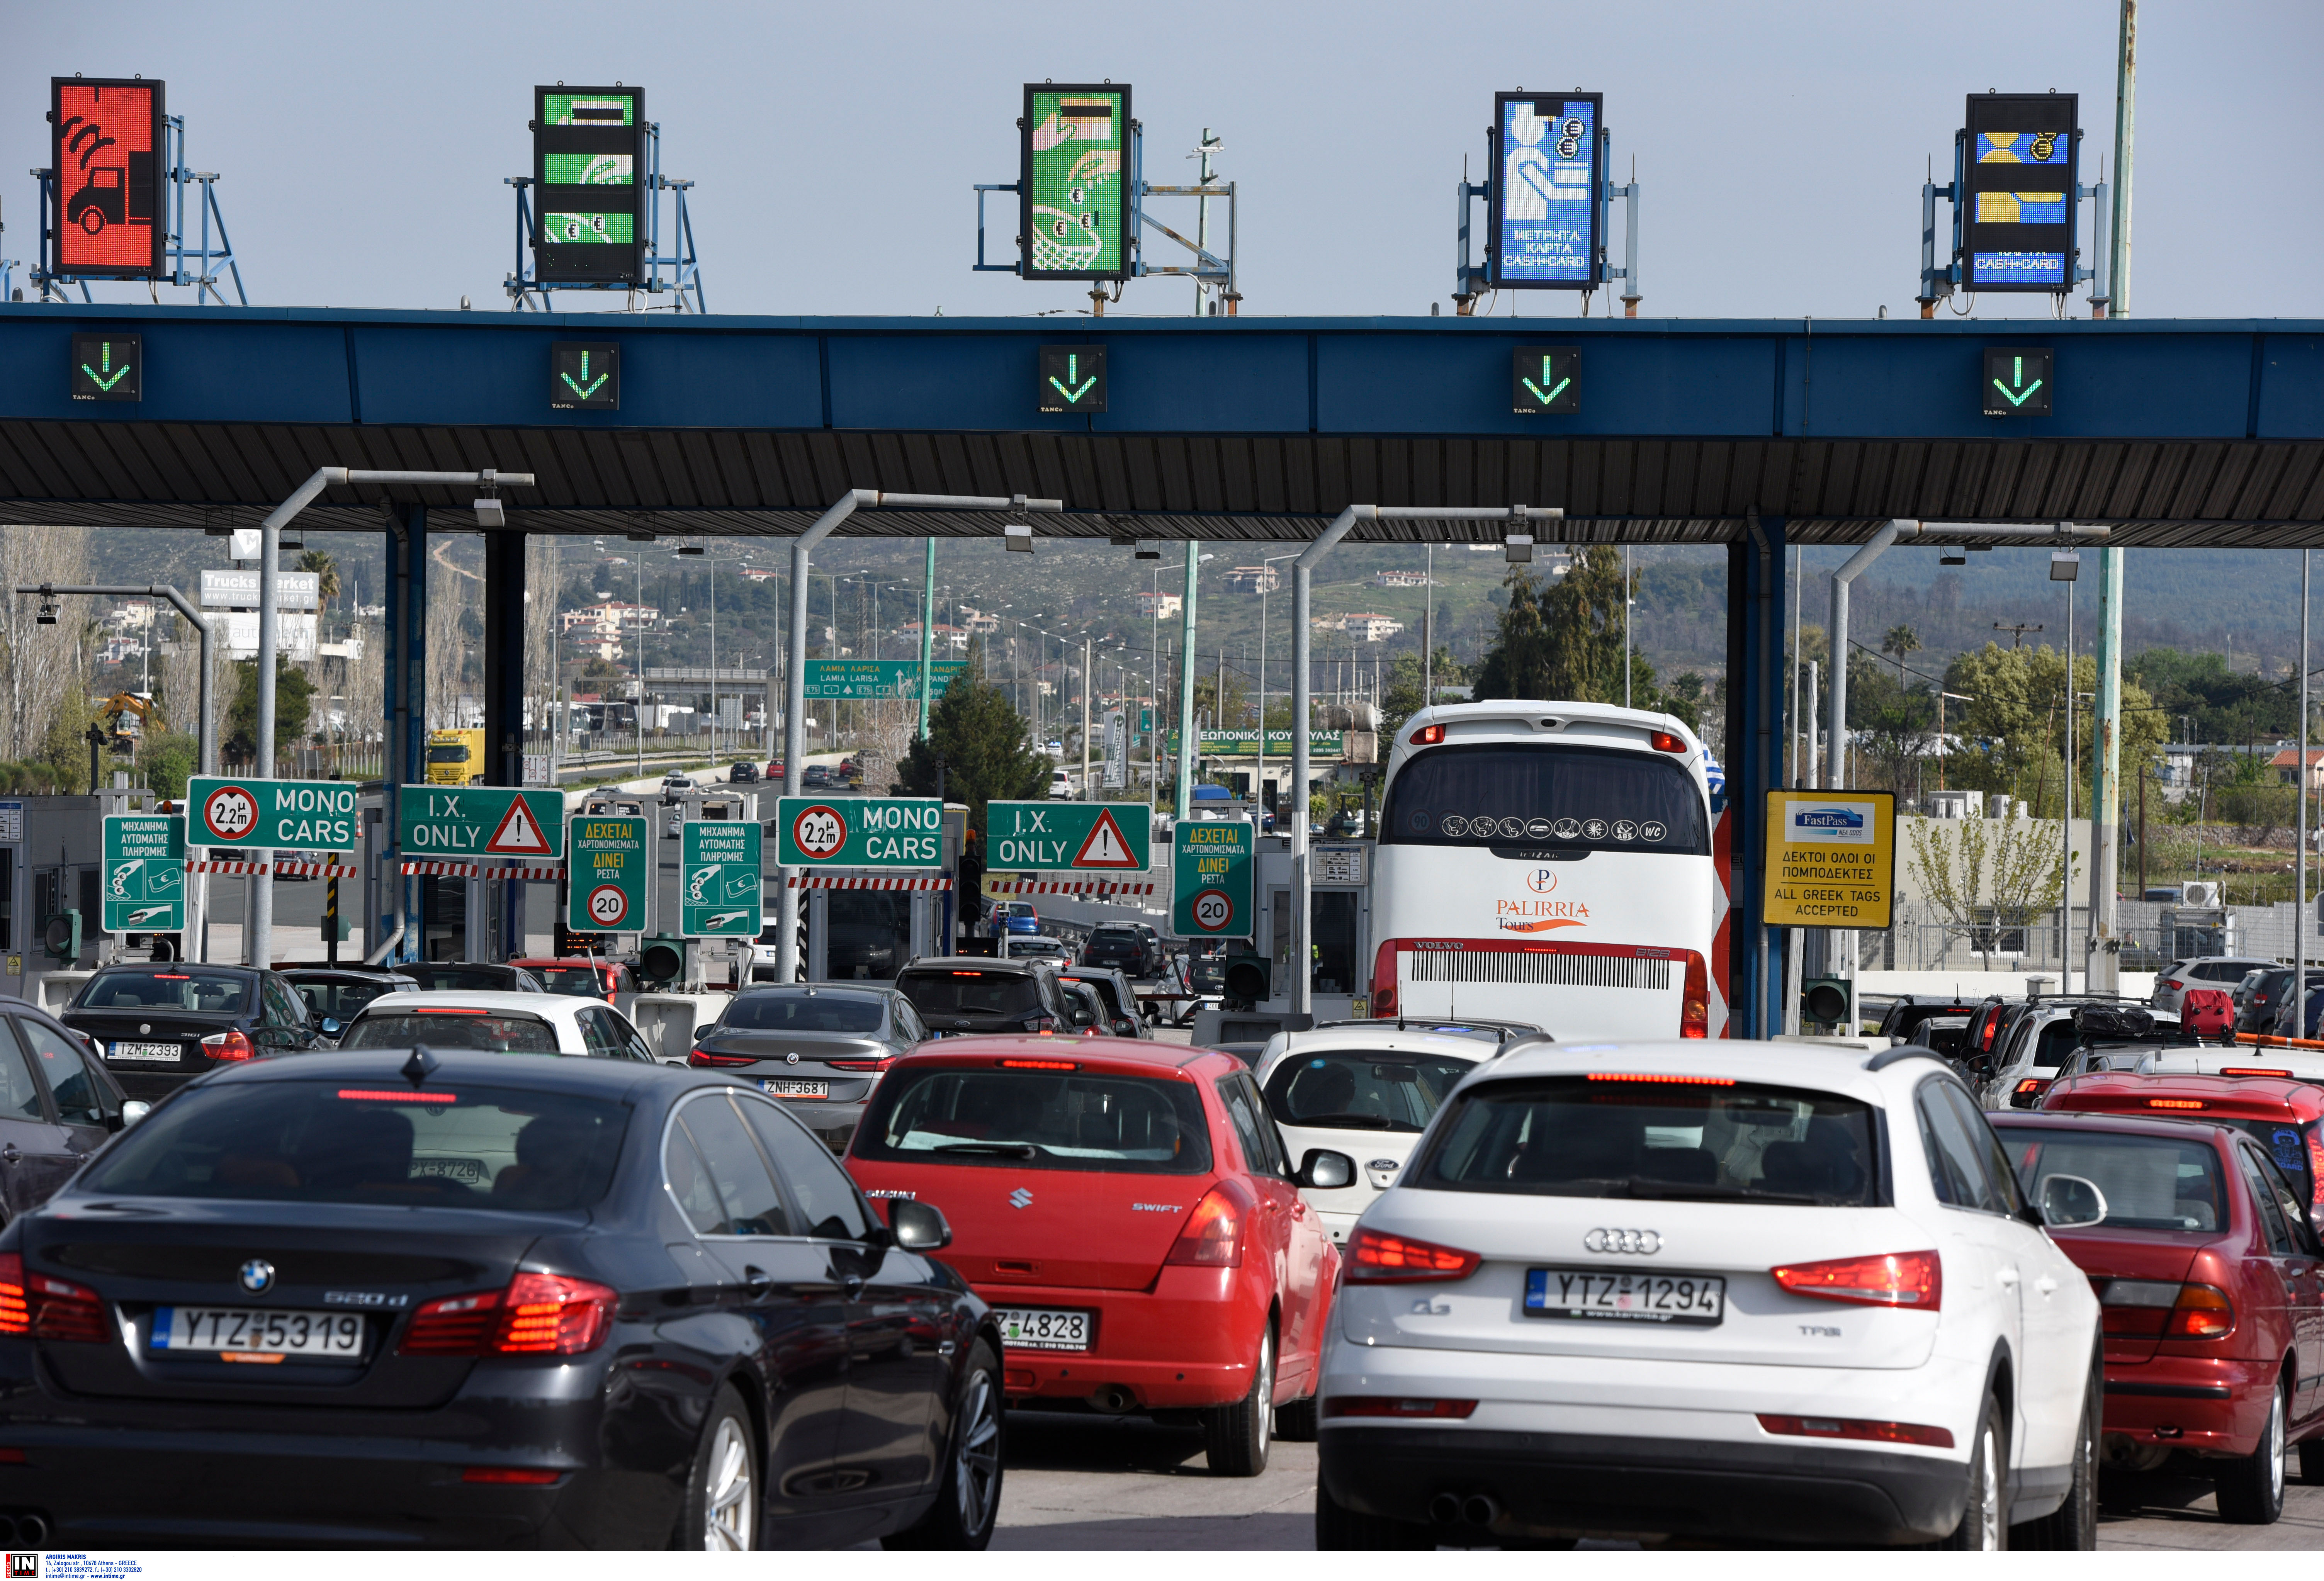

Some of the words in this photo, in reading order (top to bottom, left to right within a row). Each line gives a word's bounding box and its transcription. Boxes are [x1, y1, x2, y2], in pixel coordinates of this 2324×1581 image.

[1515, 229, 1580, 241] ΜΕΤΡΗΤΑ
[1526, 243, 1573, 254] ΚΑΡΤΑ
[204, 574, 257, 588] Trucks
[277, 577, 314, 589] arket
[204, 592, 314, 605] www.truckrket.gr
[1200, 731, 1265, 740] ΕΩΠΟΝΙΚΑ
[121, 821, 168, 832] ΜΗΧΑΝΗΜΑ
[1804, 815, 1847, 826] FastPass
[278, 819, 348, 843] CARS
[413, 824, 481, 847] ONLY
[585, 823, 632, 839] ΔΕΧΕΤΑΙ
[699, 827, 745, 837] ΜΗΧΑΝΗΜΑ
[1190, 828, 1238, 844] ΔΕΧΕΤΑΙ
[1644, 827, 1661, 837] WC
[121, 834, 168, 844] ΑΥΤΟΜΑΤΗΣ
[578, 839, 639, 849] ΧΑΡΤΟΝΟΜΙΣΜΑΤΑ
[699, 839, 745, 849] ΑΥΤΟΜΑΤΗΣ
[122, 846, 167, 857] ΠΛΗΡΩΜΗΣ
[866, 837, 936, 860] CARS
[999, 840, 1067, 863] ONLY
[1182, 844, 1245, 854] ΧΑΡΤΟΝΟΜΙΣΜΑΤΑ
[593, 853, 624, 868] ΔΙΝΕΙ
[700, 852, 744, 862] ΠΛΗΡΩΜΗΣ
[1782, 851, 1825, 863] ΔΕΚΤΟΙ
[1831, 852, 1858, 864] ΟΛΟΙ
[1864, 853, 1875, 864] ΟΙ
[1198, 857, 1229, 873] ΔΙΝΕΙ
[596, 869, 620, 879] ΡΕΣΤΑ
[1201, 874, 1225, 884] ΡΕΣΤΑ
[1782, 866, 1873, 880] ΠΟΜΠΟΔΕΚΤΕΣ
[1774, 888, 1797, 900] ALL
[1803, 889, 1844, 901] GREEK
[1850, 890, 1881, 902] TAGS
[596, 897, 619, 914] 20
[1201, 902, 1225, 919] 20
[1496, 899, 1590, 917] PALIRRIA
[1795, 904, 1858, 917] ACCEPTED
[1496, 917, 1534, 931] Tours
[1413, 941, 1464, 950] VOLVO
[1635, 948, 1670, 958] B12B
[1374, 1160, 1395, 1169] Ford
[1131, 1203, 1182, 1213] SWIFT
[996, 1312, 1083, 1339] Z-4828
